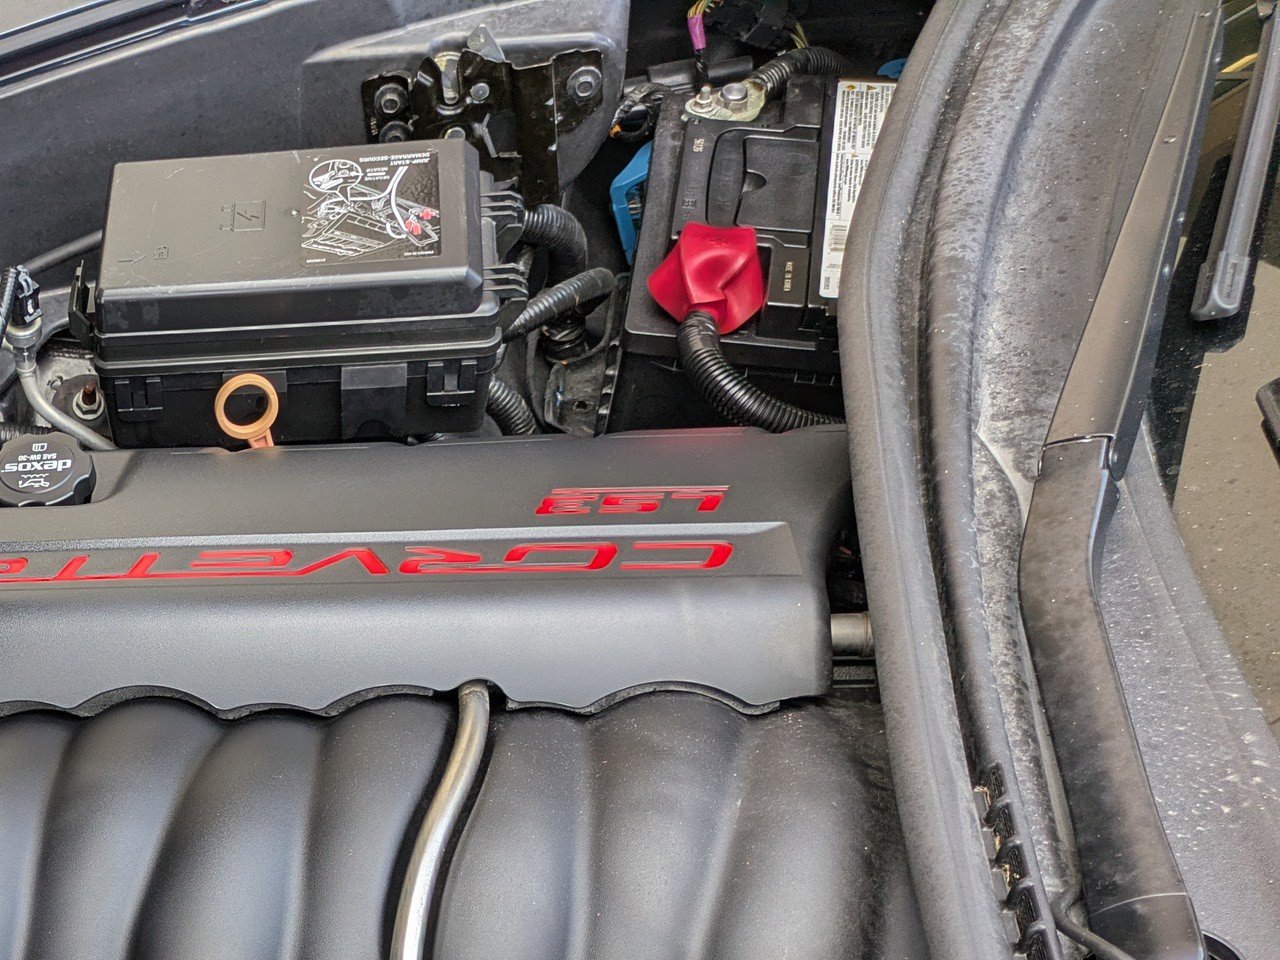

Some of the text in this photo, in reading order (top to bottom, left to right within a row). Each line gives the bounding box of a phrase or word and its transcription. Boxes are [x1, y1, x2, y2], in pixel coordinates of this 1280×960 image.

[18, 452, 58, 462] SAE 5W-30
[534, 486, 730, 516] LS3
